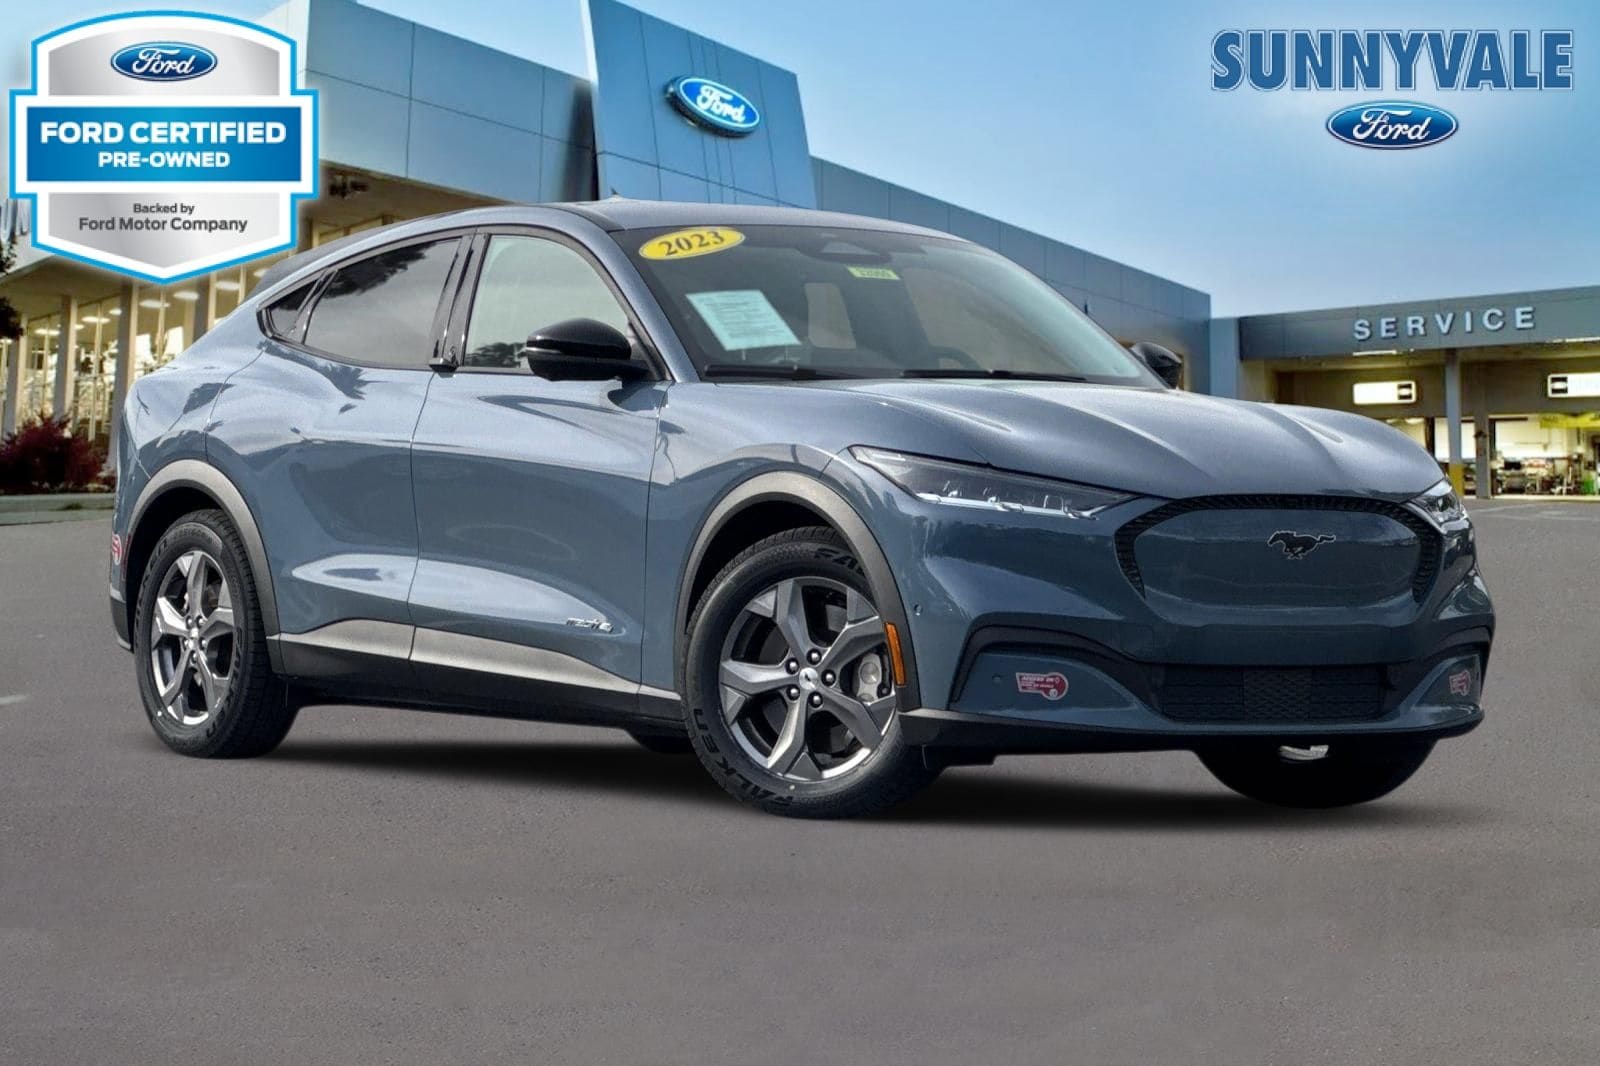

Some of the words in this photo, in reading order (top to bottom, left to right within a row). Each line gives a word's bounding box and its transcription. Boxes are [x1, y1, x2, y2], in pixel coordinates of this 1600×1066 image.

[696, 84, 746, 122] Ford
[658, 231, 724, 256] 2023
[1353, 306, 1536, 341] SERVICE
